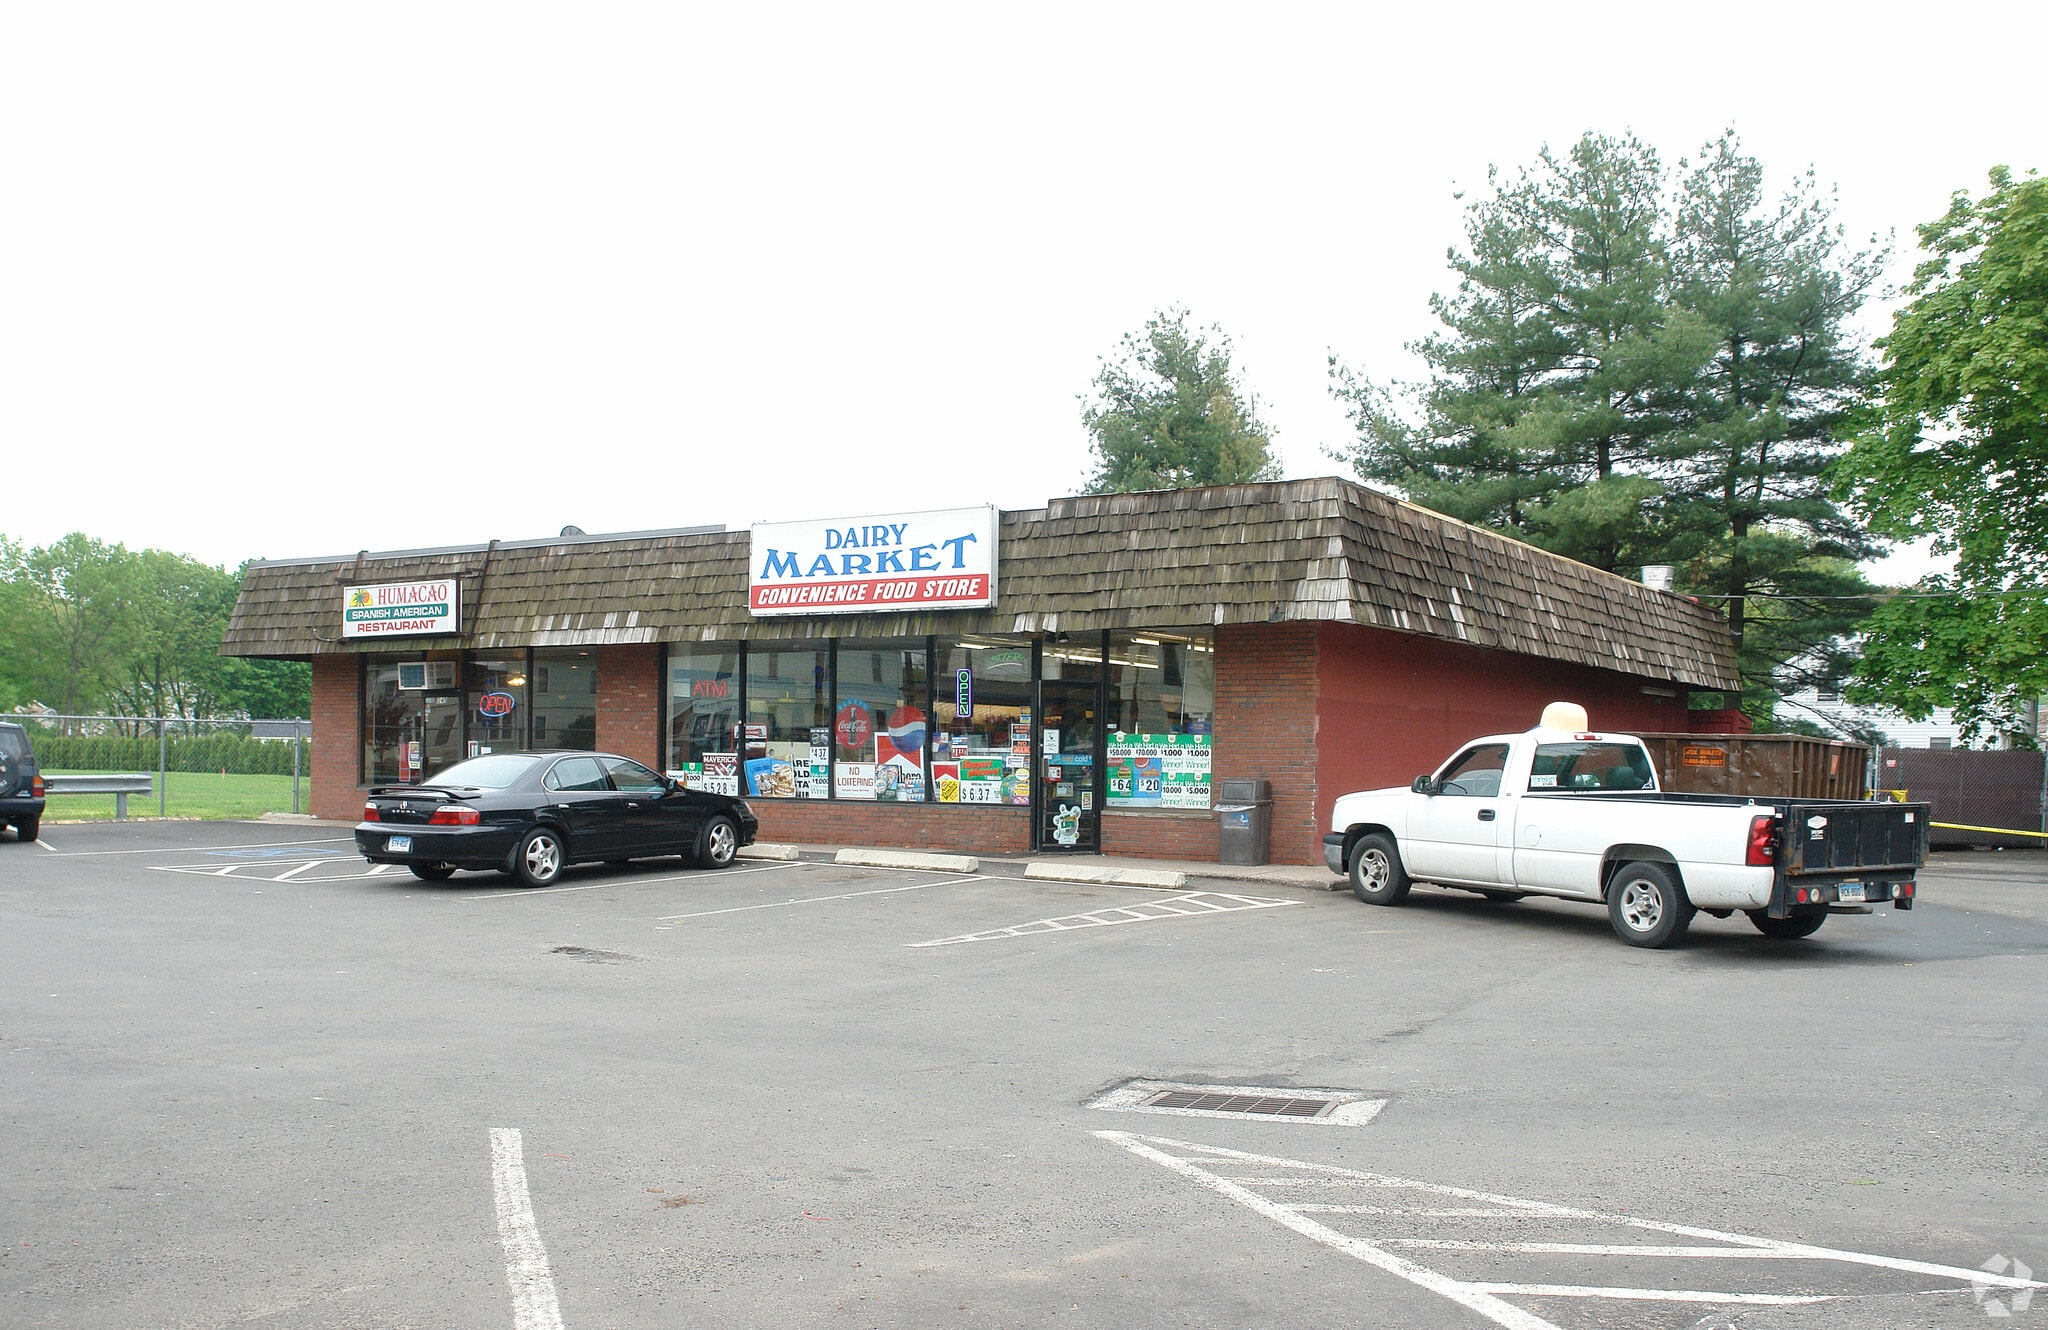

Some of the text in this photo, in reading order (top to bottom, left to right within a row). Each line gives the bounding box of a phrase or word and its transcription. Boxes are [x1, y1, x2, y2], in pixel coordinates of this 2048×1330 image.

[825, 523, 908, 550] DAIRY
[760, 533, 977, 579] MARKET
[378, 583, 447, 606] HUMACAO
[757, 578, 981, 605] CONVENIENCE FOOD STORE
[351, 606, 442, 620] SPANISH AMERICAN
[357, 620, 436, 633] RESTAURANT
[959, 671, 969, 715] OPEN
[480, 695, 512, 714] OPEN
[838, 720, 868, 733] Coca-Cola
[848, 767, 860, 775] NO
[1185, 761, 1209, 769] Winner!
[837, 777, 874, 787] LOITERING
